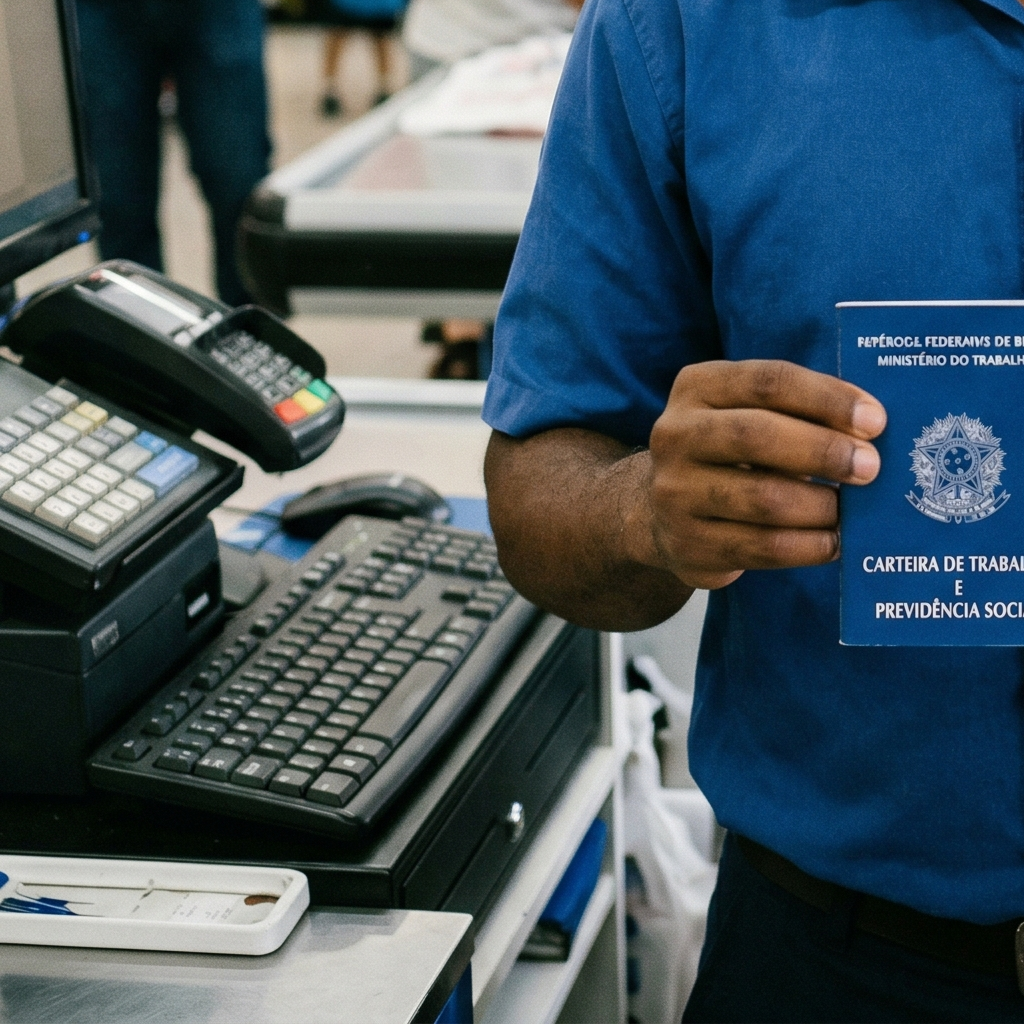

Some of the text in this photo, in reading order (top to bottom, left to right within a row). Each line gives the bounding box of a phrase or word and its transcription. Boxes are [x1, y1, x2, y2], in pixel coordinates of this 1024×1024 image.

[994, 335, 1011, 347] DE
[877, 351, 947, 367] MINISTÉRIO
[949, 355, 969, 366] DO
[862, 556, 940, 573] CARTEIRA
[943, 555, 965, 572] DE
[954, 579, 964, 596] E
[875, 597, 981, 619] PREVIDÊNCIA
